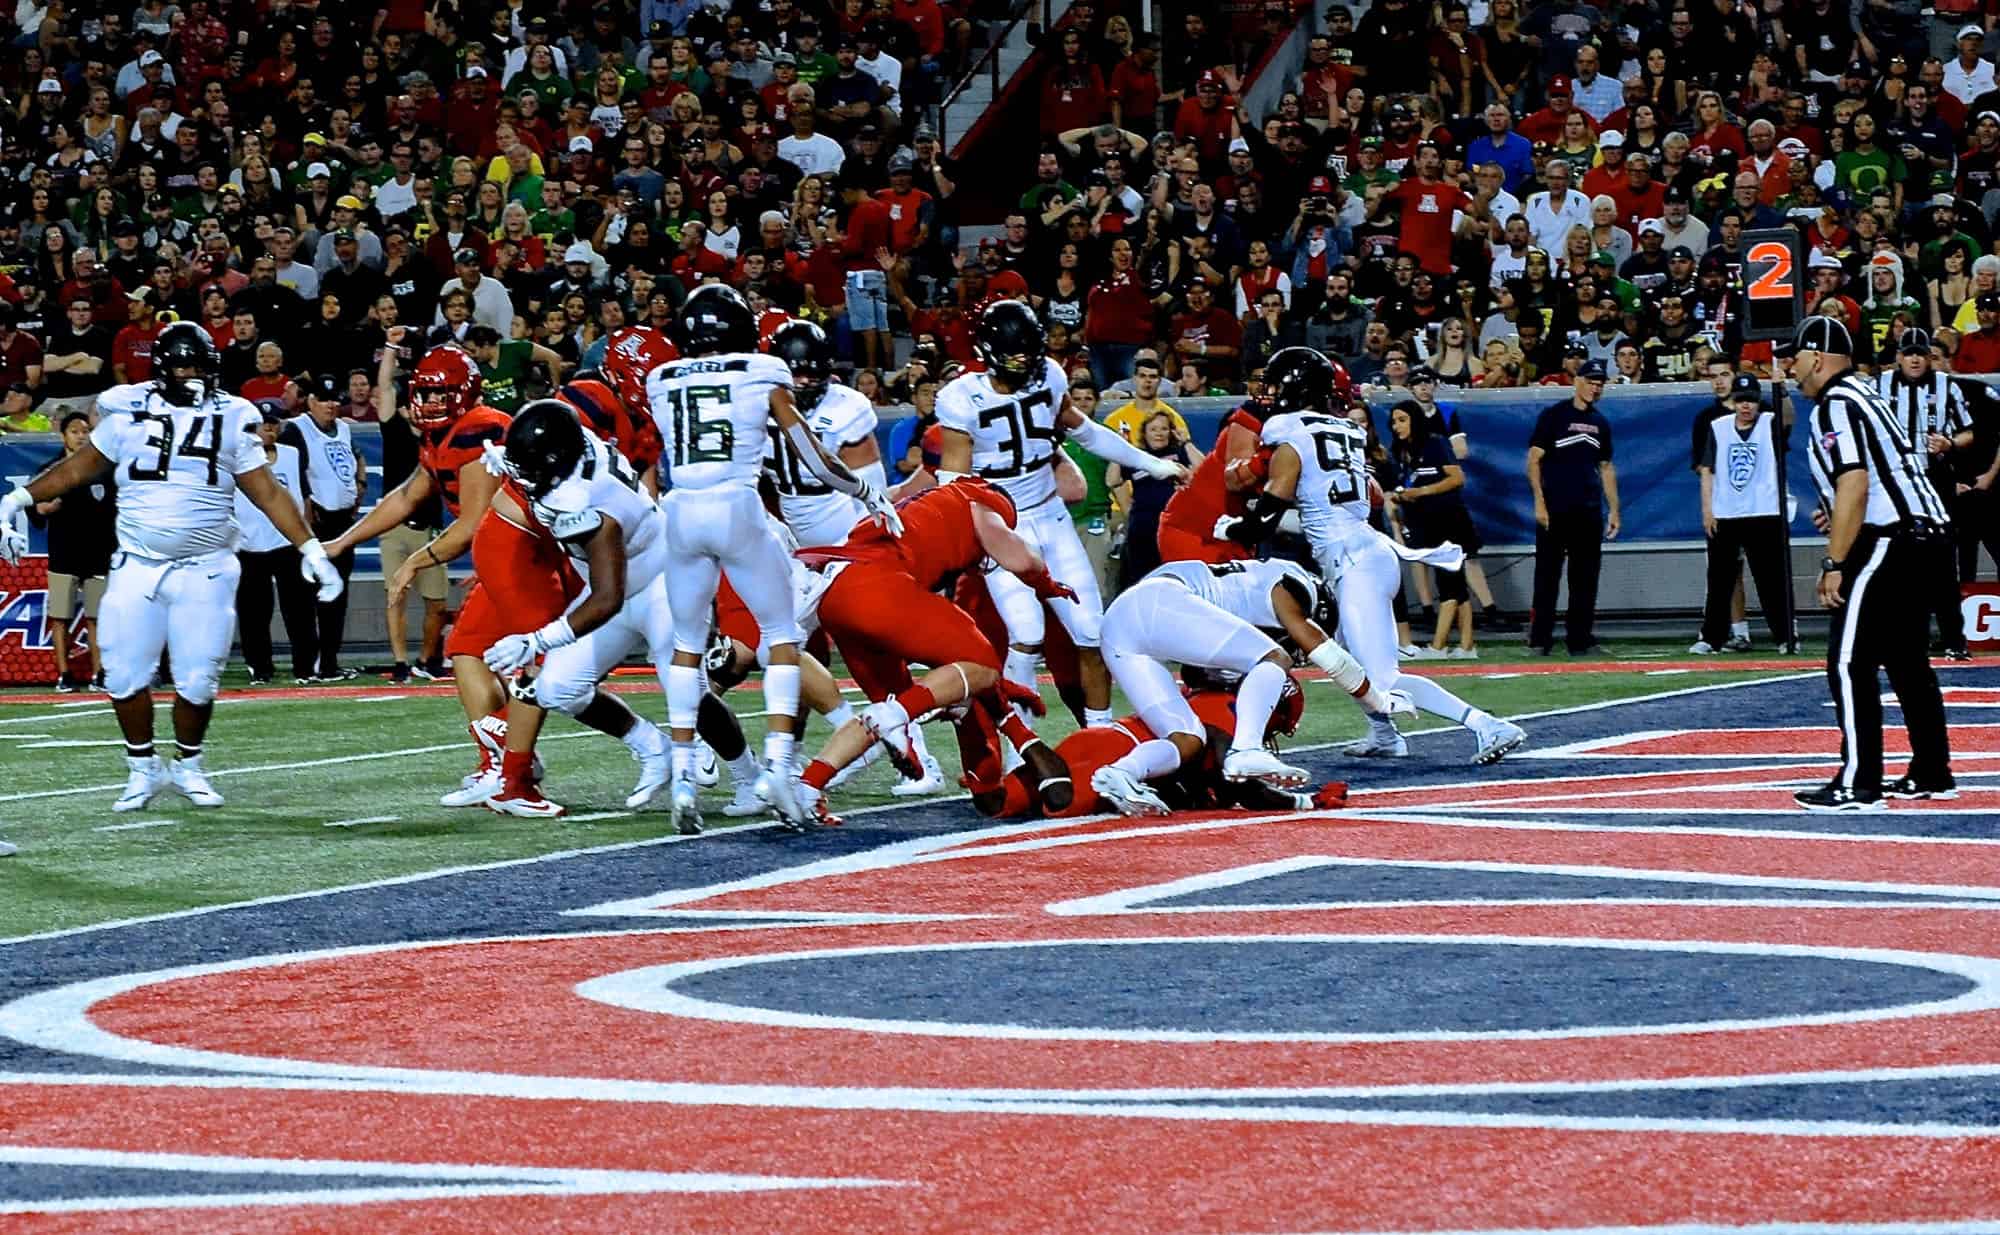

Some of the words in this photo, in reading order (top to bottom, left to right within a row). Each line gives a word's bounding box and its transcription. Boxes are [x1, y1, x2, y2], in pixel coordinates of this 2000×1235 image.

[1746, 242, 1794, 300] 2
[128, 411, 223, 486] 34
[667, 384, 733, 467] 16
[979, 387, 1065, 479] 35
